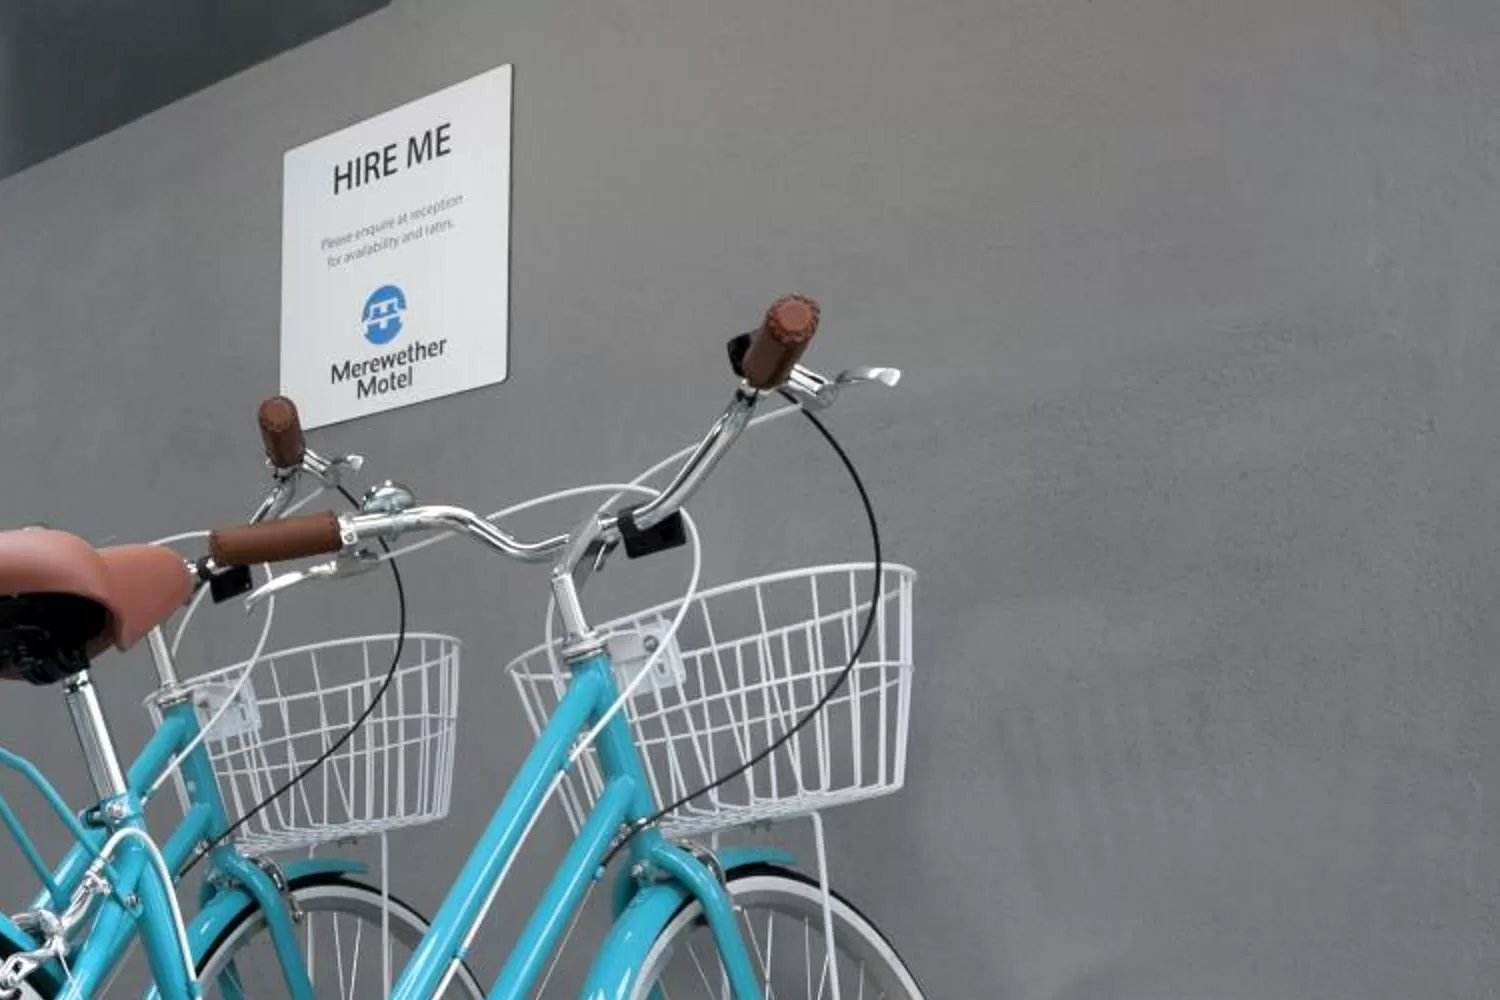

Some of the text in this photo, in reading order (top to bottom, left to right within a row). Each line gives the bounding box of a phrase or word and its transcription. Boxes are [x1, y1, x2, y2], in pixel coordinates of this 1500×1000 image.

[333, 123, 451, 194] HIRE ME
[320, 195, 463, 251] Please enquire at reception
[327, 254, 342, 268] for
[343, 237, 401, 263] availability
[402, 225, 423, 244] and
[332, 338, 447, 400] Merewether Motel
